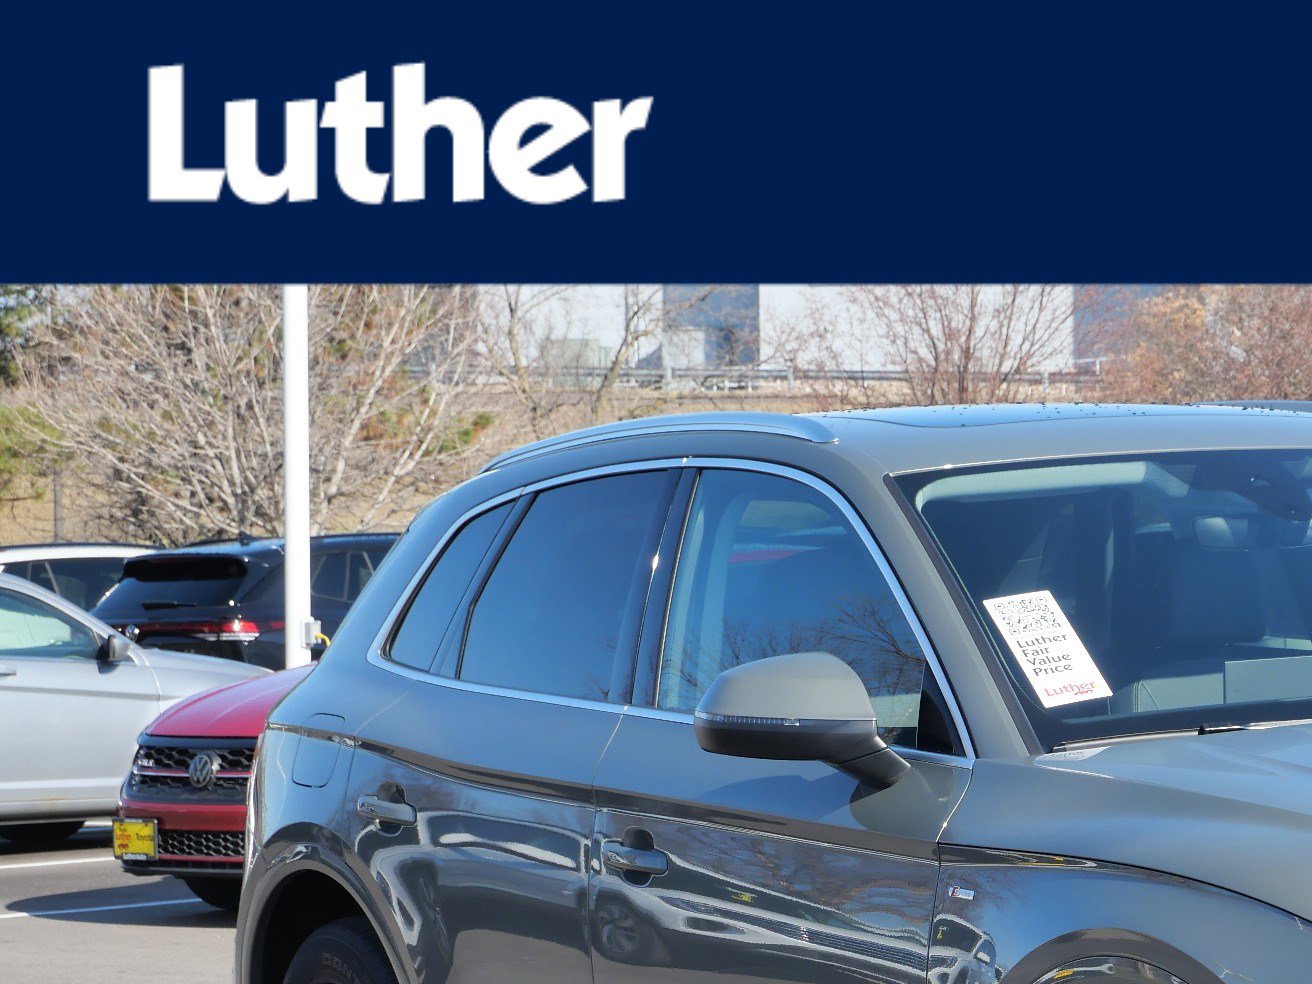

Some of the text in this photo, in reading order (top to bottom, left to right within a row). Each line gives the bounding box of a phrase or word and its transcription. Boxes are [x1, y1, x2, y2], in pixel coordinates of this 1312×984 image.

[1016, 633, 1067, 649] Luther
[1022, 646, 1050, 658] Fair
[1026, 652, 1072, 666] Value
[1033, 664, 1073, 676] Price
[1044, 681, 1096, 697] Luther
